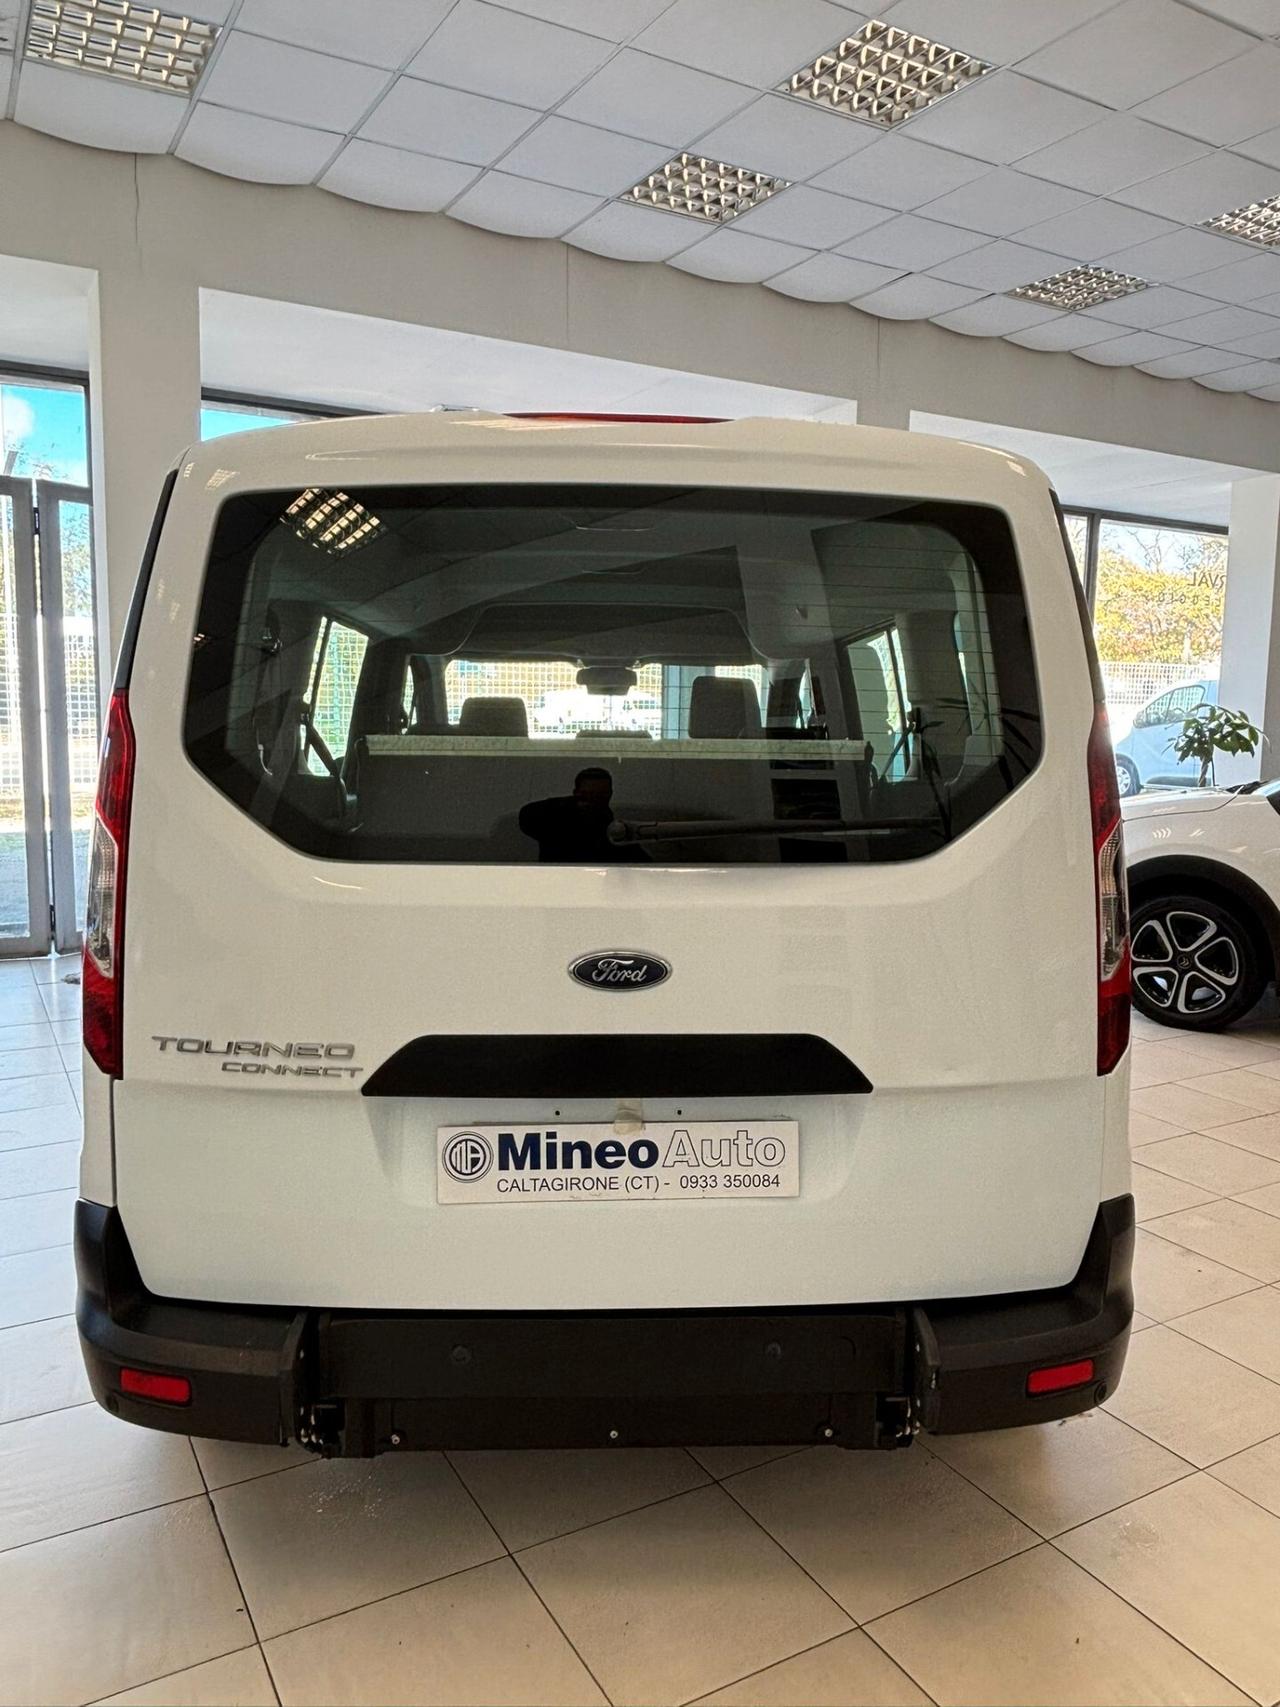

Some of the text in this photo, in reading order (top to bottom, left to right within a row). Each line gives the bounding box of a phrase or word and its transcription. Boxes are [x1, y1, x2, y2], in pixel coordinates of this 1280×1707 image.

[591, 958, 648, 982] Ford
[151, 1036, 355, 1060] TOURNEO
[221, 1061, 364, 1079] CONNECT
[496, 1176, 619, 1193] CALTAGIRONE
[624, 1175, 660, 1193] (CT)
[679, 1174, 718, 1189] 0933
[723, 1174, 781, 1188] 350084
